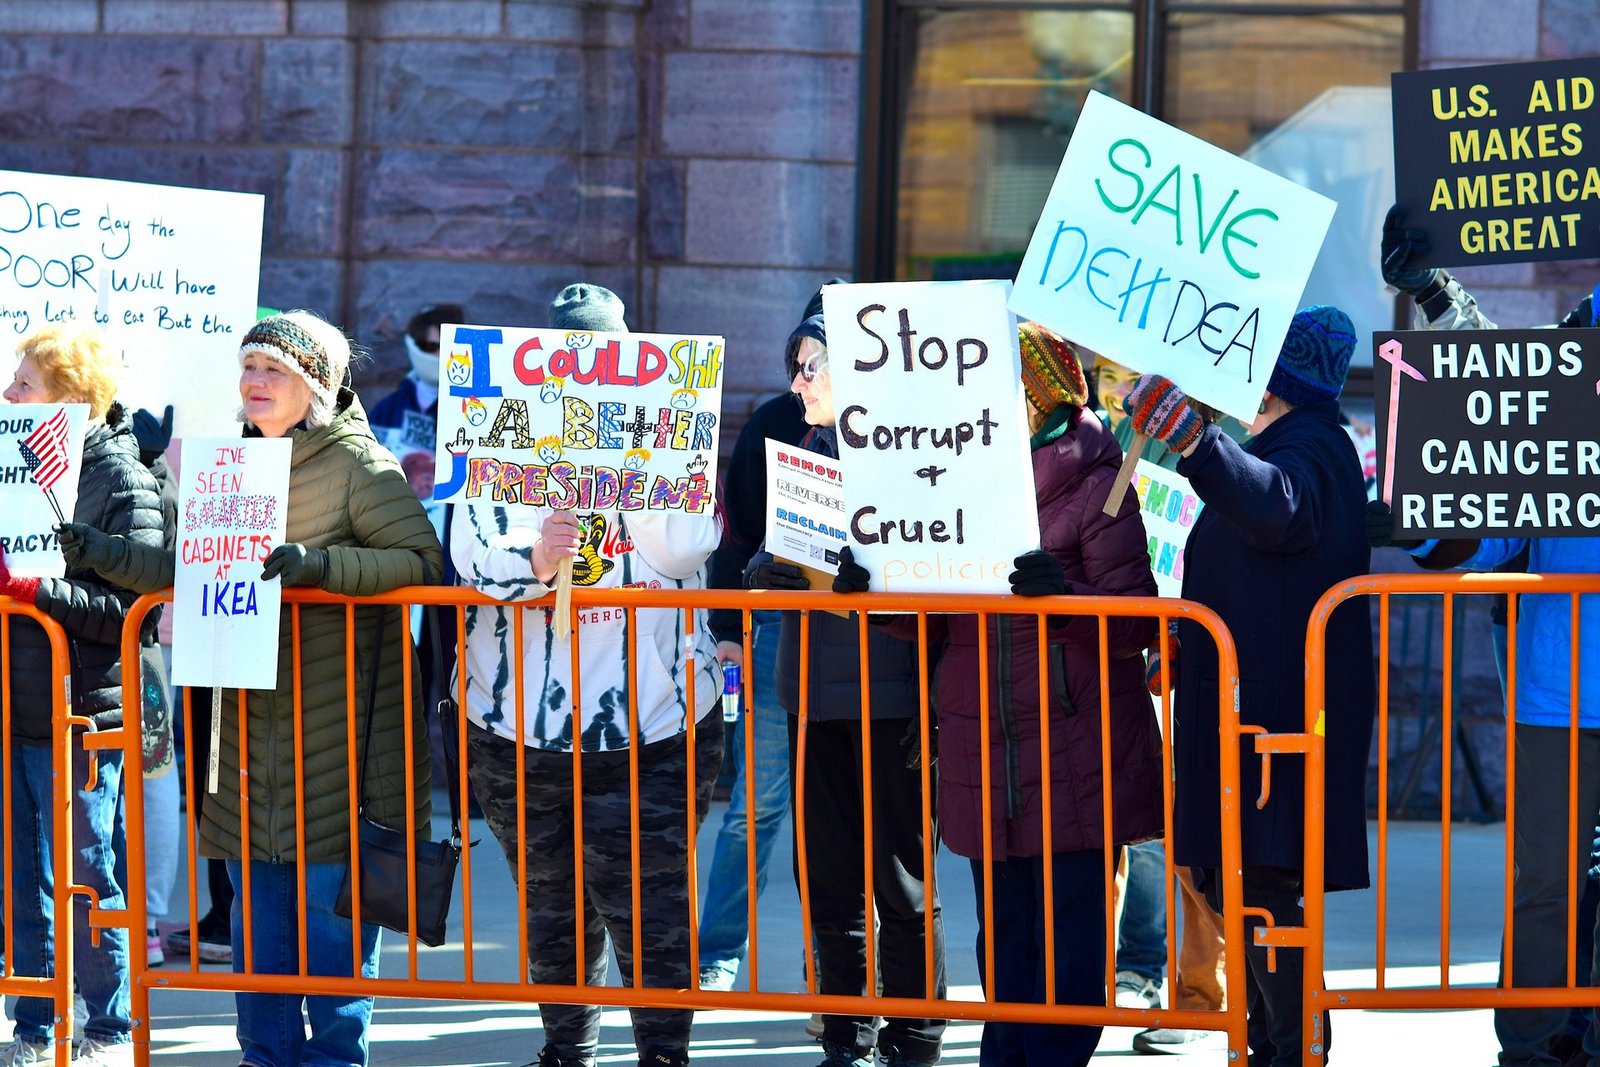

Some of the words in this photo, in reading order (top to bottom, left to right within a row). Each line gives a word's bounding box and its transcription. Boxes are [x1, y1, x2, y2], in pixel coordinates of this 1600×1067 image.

[1432, 84, 1497, 120] U.S.
[1528, 77, 1594, 113] AID
[1450, 123, 1582, 164] MAKES
[1429, 167, 1600, 211] AMERICA
[0, 191, 80, 233] One
[99, 203, 131, 259] day
[147, 216, 175, 236] the
[1095, 138, 1279, 279] SAVE
[1460, 213, 1581, 254] GREAT
[176, 269, 216, 294] have
[94, 305, 109, 323] to
[124, 312, 144, 324] eat
[154, 306, 191, 330] But
[203, 314, 232, 333] the
[449, 327, 503, 398] I
[854, 303, 988, 386] Stop
[1432, 341, 1583, 379] HANDS
[478, 398, 535, 449] A
[1466, 390, 1549, 425] OFF
[839, 405, 999, 456] Corrupt
[1421, 438, 1600, 475] CANCER
[195, 472, 243, 493] SEEN
[777, 478, 846, 513] REVERSE
[776, 507, 847, 542] RECLAIM
[850, 505, 964, 545] Cruel
[1402, 493, 1600, 529] RESEARC
[182, 534, 272, 565] CABINETS
[215, 564, 231, 580] AT
[202, 581, 258, 617] IKEA
[655, 1054, 671, 1064] FILA
